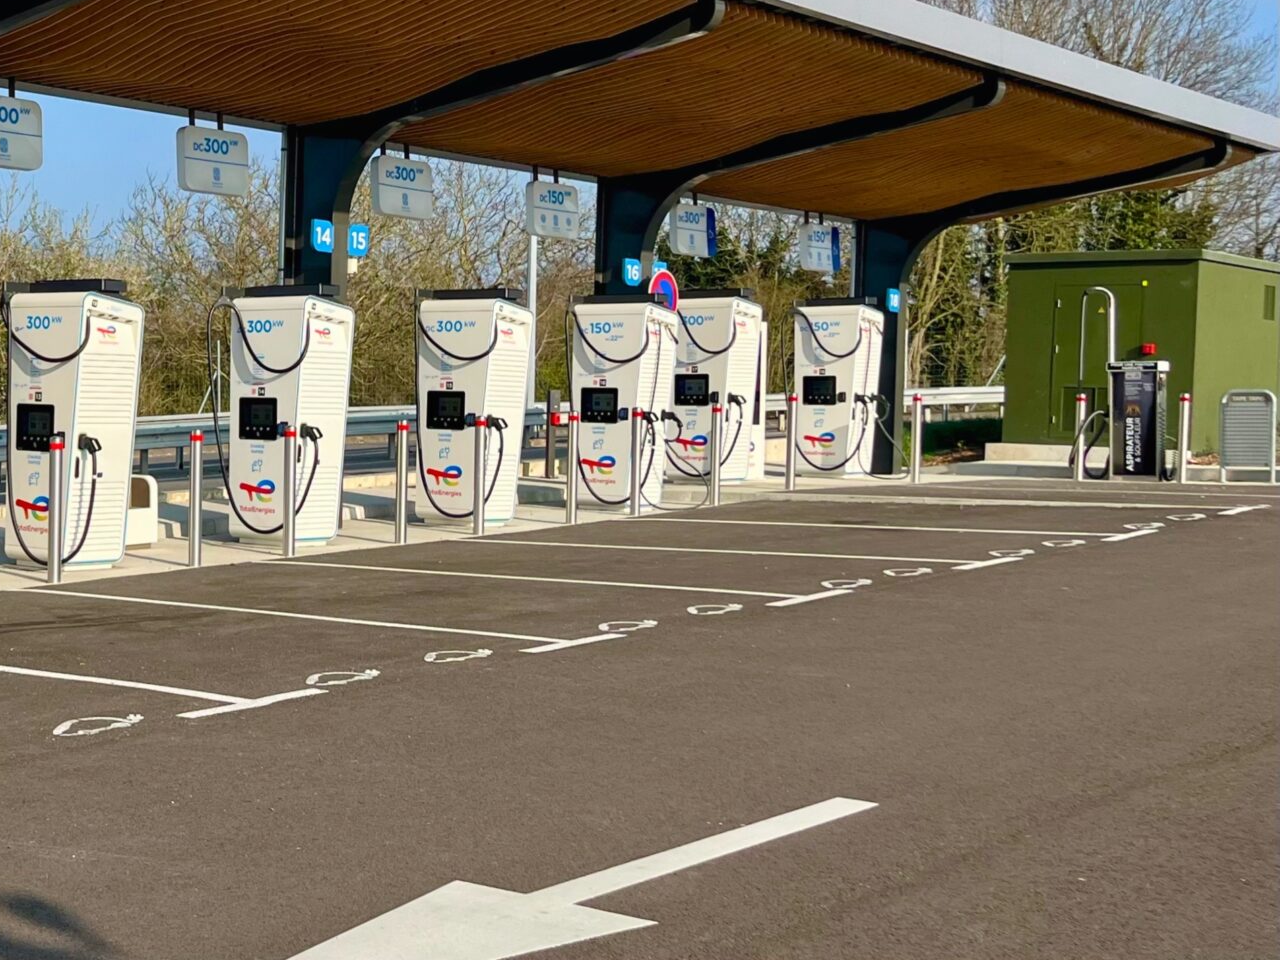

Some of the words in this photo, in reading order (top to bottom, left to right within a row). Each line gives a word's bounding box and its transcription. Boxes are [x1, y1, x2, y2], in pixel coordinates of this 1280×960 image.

[315, 226, 332, 246] 14
[351, 231, 367, 250] 15
[626, 264, 640, 281] 16
[1125, 417, 1135, 472] ASPIRATEUR
[1134, 417, 1142, 456] SOUFFLEUR
